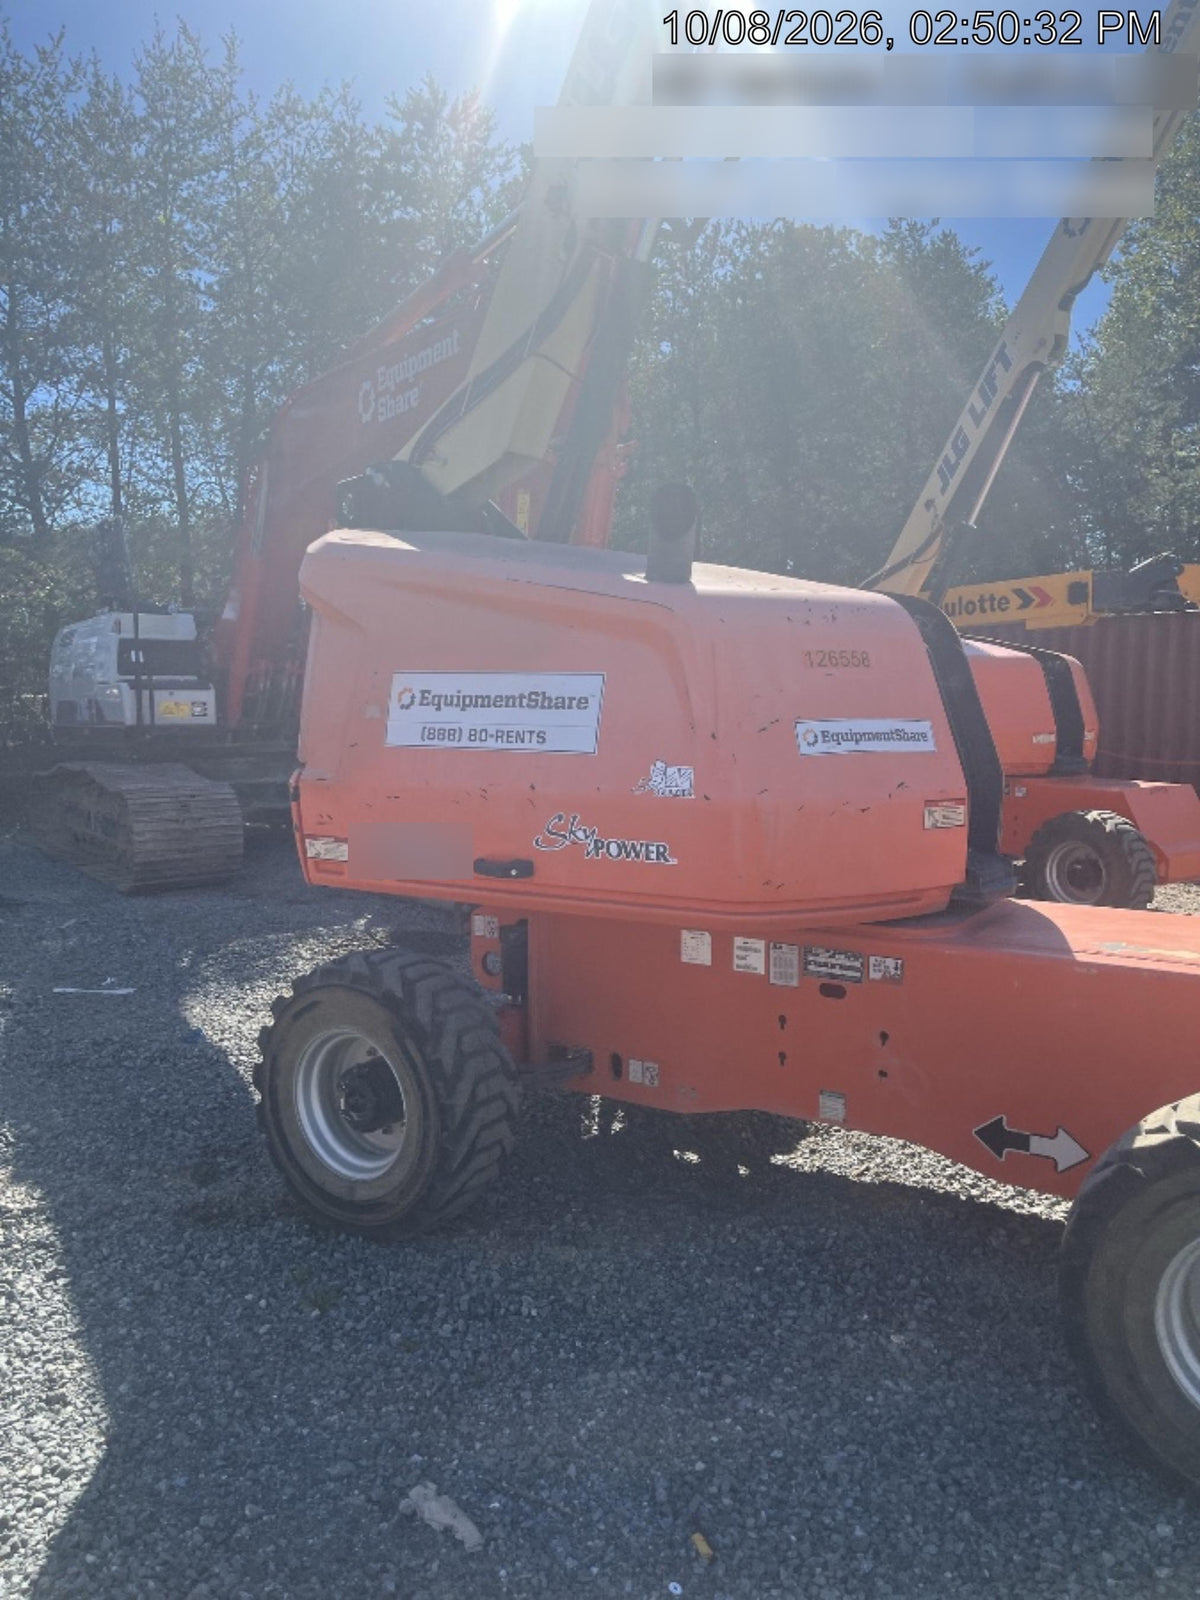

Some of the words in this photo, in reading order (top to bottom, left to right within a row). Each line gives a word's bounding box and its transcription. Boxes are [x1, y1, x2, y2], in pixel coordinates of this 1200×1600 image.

[376, 328, 461, 392] Equipment
[377, 386, 419, 423] Share
[937, 424, 971, 496] JLG
[968, 340, 1013, 429] LIFT
[804, 650, 870, 669] 126558
[419, 689, 589, 712] EquipmentShare
[420, 725, 463, 743] (888)
[468, 727, 547, 745] 80-RENTS
[821, 728, 928, 746] EquipmentShare
